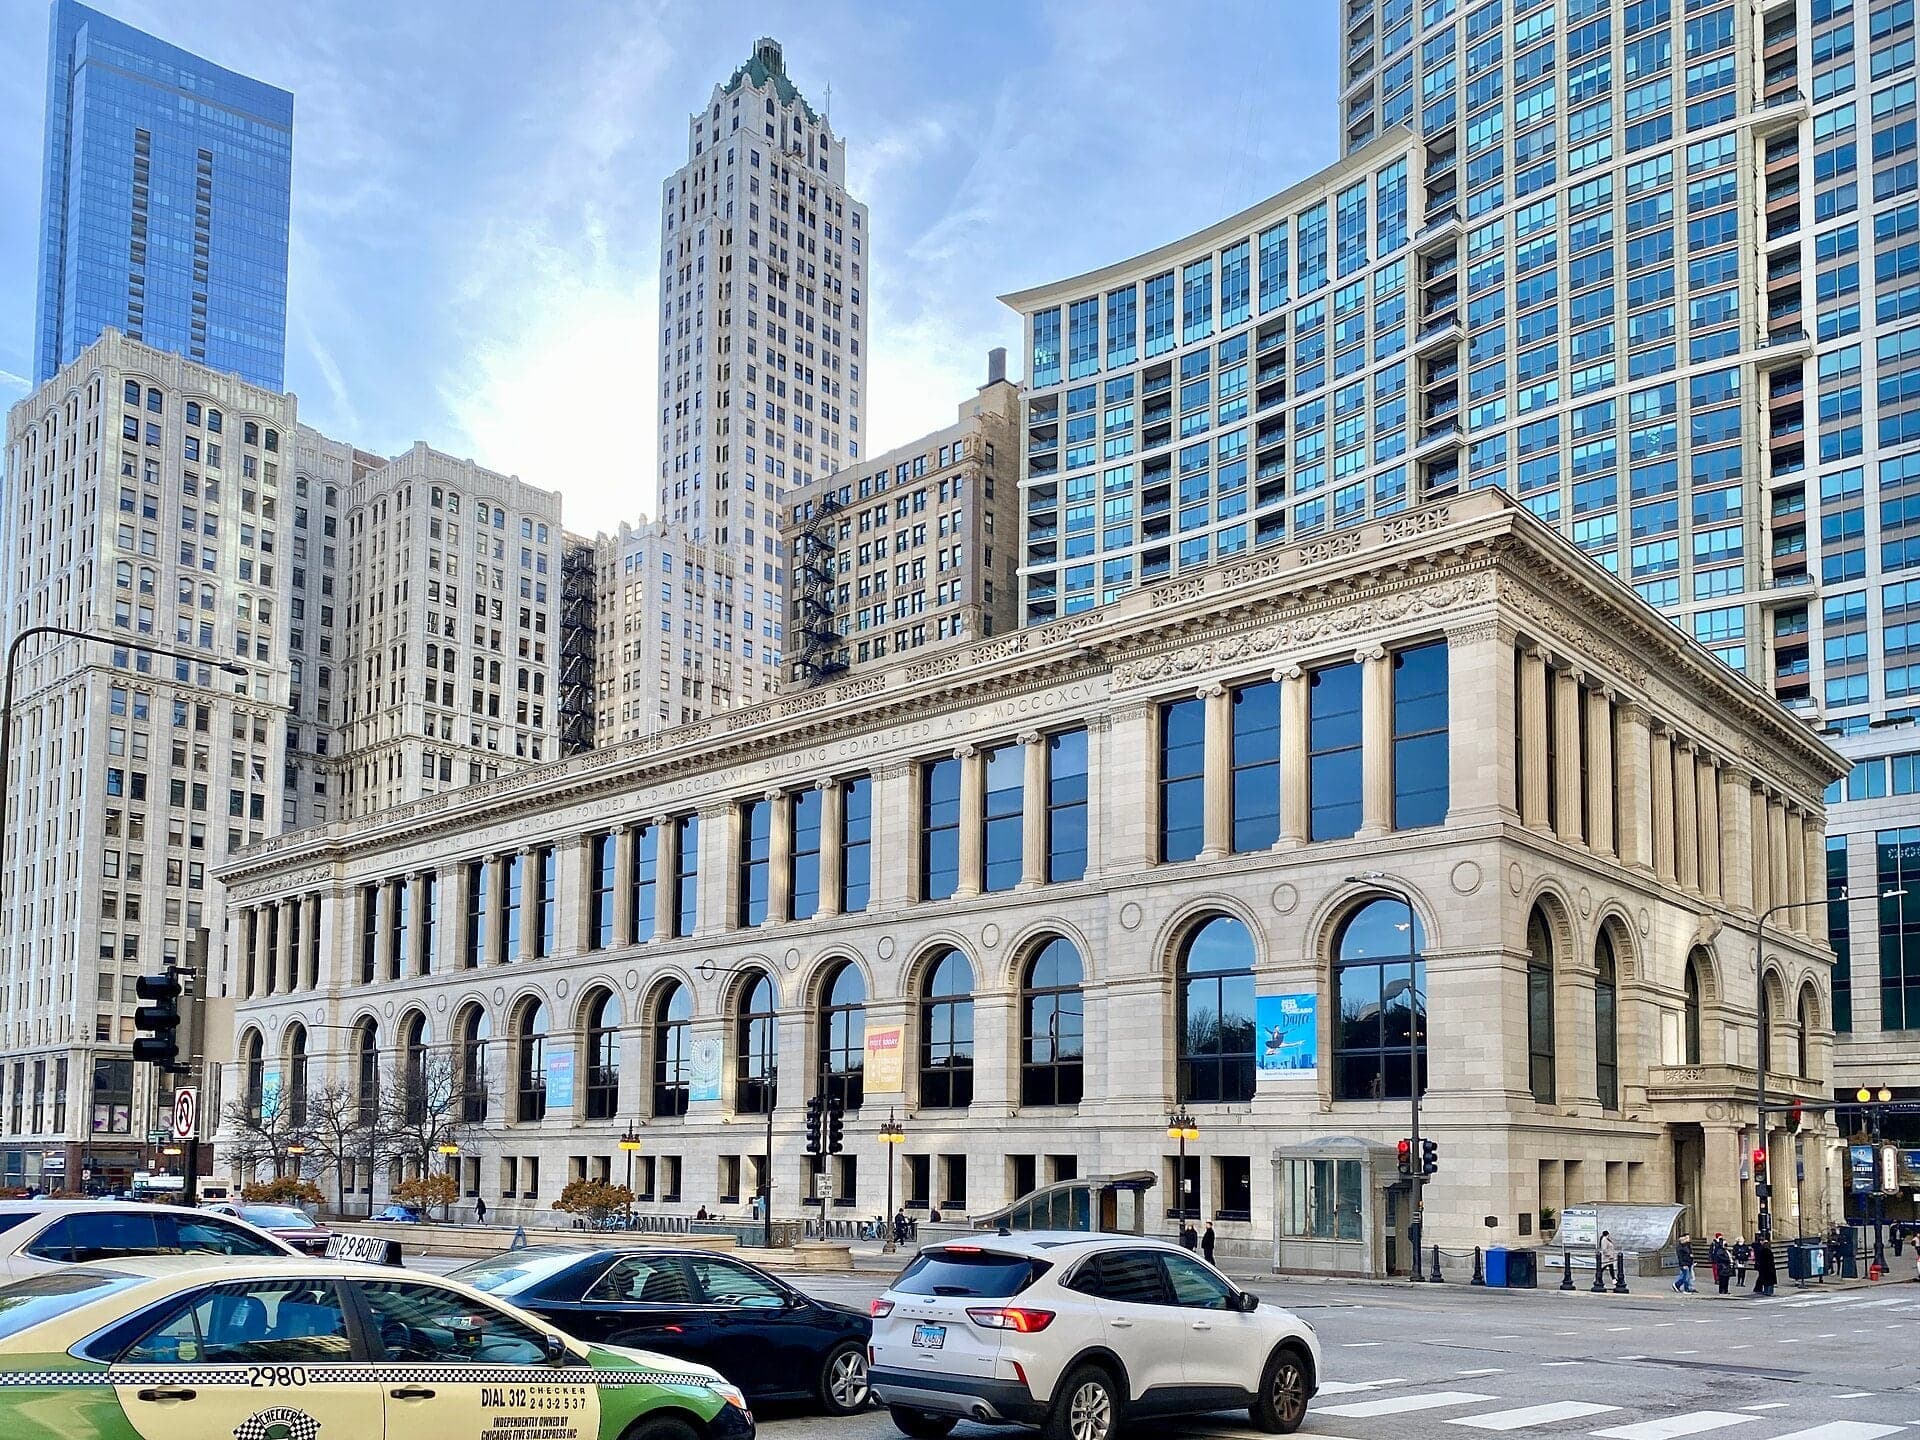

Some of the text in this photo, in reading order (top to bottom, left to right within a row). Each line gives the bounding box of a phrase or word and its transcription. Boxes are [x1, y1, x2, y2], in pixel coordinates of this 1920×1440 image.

[839, 723, 930, 756] COMPLETED
[993, 682, 1094, 719] MDCCCXCV
[339, 1235, 371, 1257] 2980
[248, 1366, 307, 1388] 2980
[481, 1388, 527, 1407] DIAL 312
[529, 1386, 586, 1395] CHECKER
[258, 1407, 298, 1426] CHECKER
[493, 1416, 569, 1428] INDEPENDENTLY OWNED BY
[513, 1429, 526, 1440] FIVE
[526, 1429, 540, 1440] STAR
[542, 1429, 567, 1439] EXPRESS
[567, 1428, 578, 1439] INC
